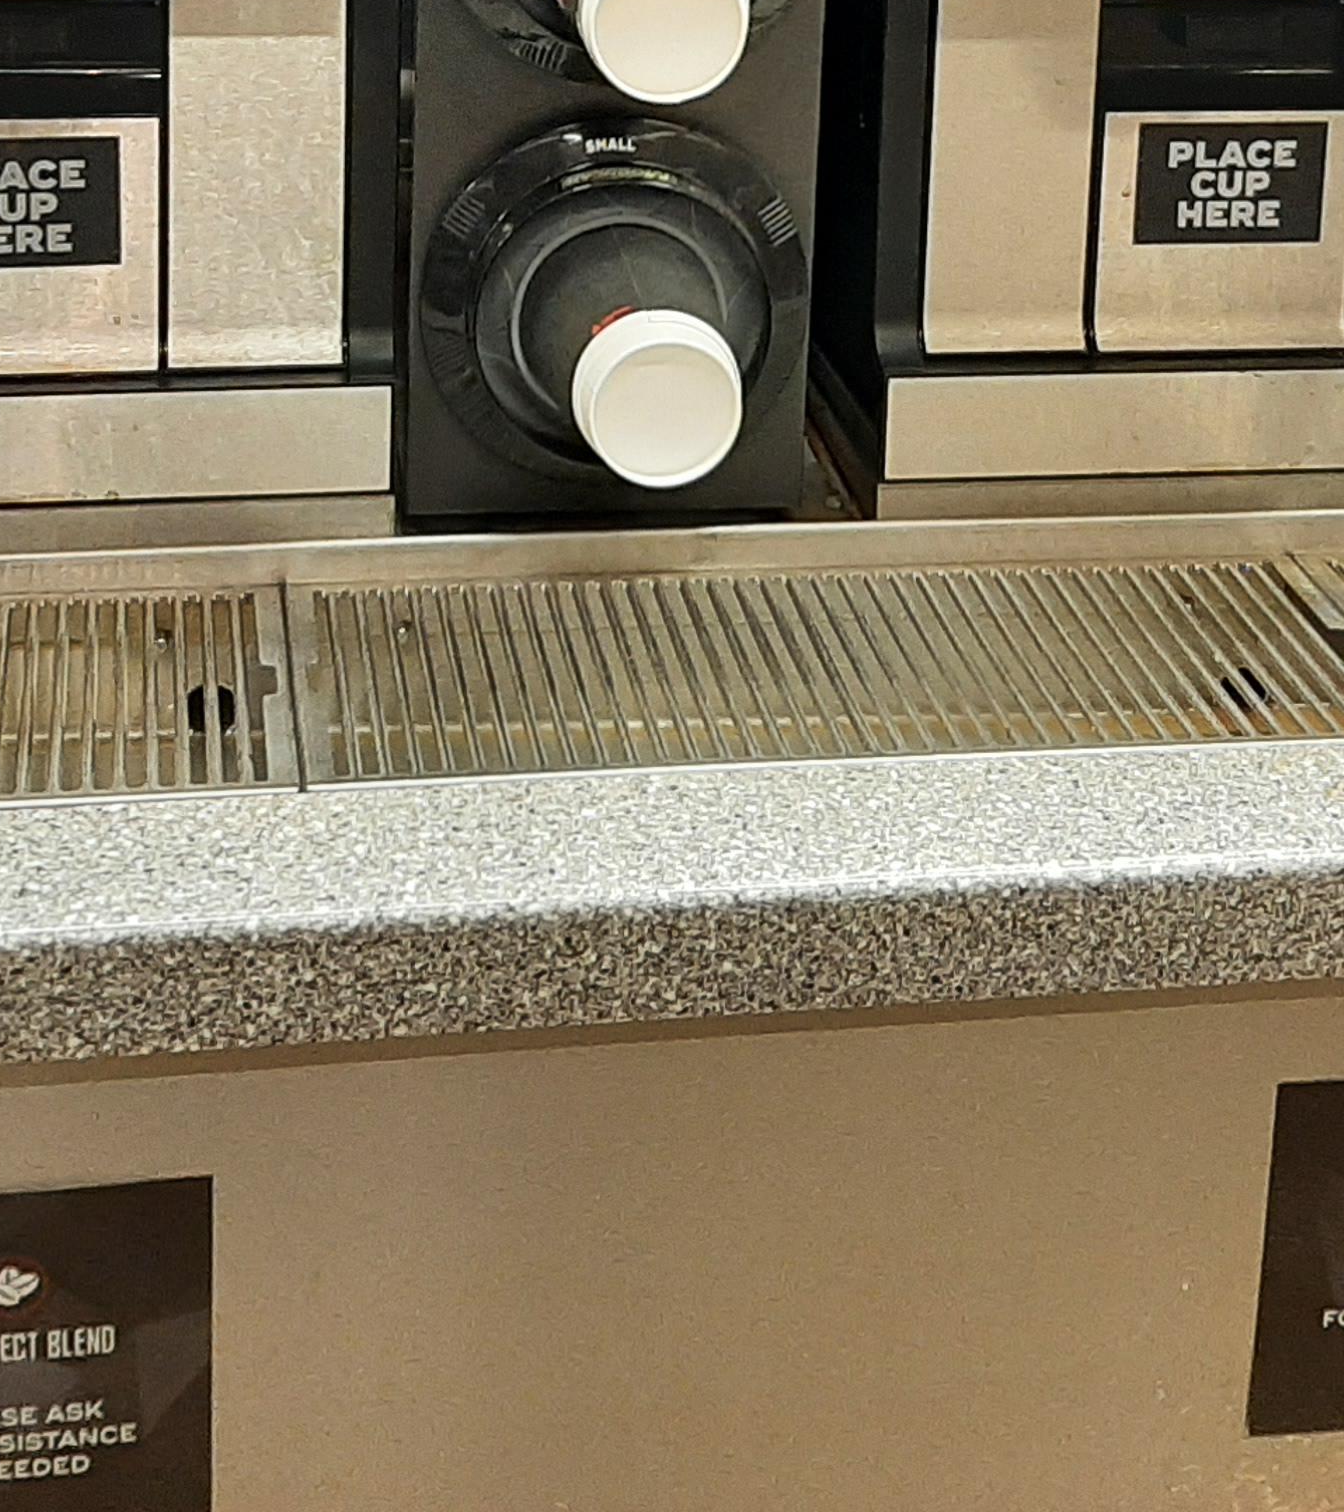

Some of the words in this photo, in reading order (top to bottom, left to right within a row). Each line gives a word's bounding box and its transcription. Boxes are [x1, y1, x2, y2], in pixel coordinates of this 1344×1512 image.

[585, 137, 636, 155] SMALL
[1167, 139, 1298, 169] PLACE
[1190, 170, 1271, 198] CUP
[1176, 199, 1281, 228] HERE
[46, 1324, 116, 1360] BLEND
[44, 1399, 104, 1425] ASK
